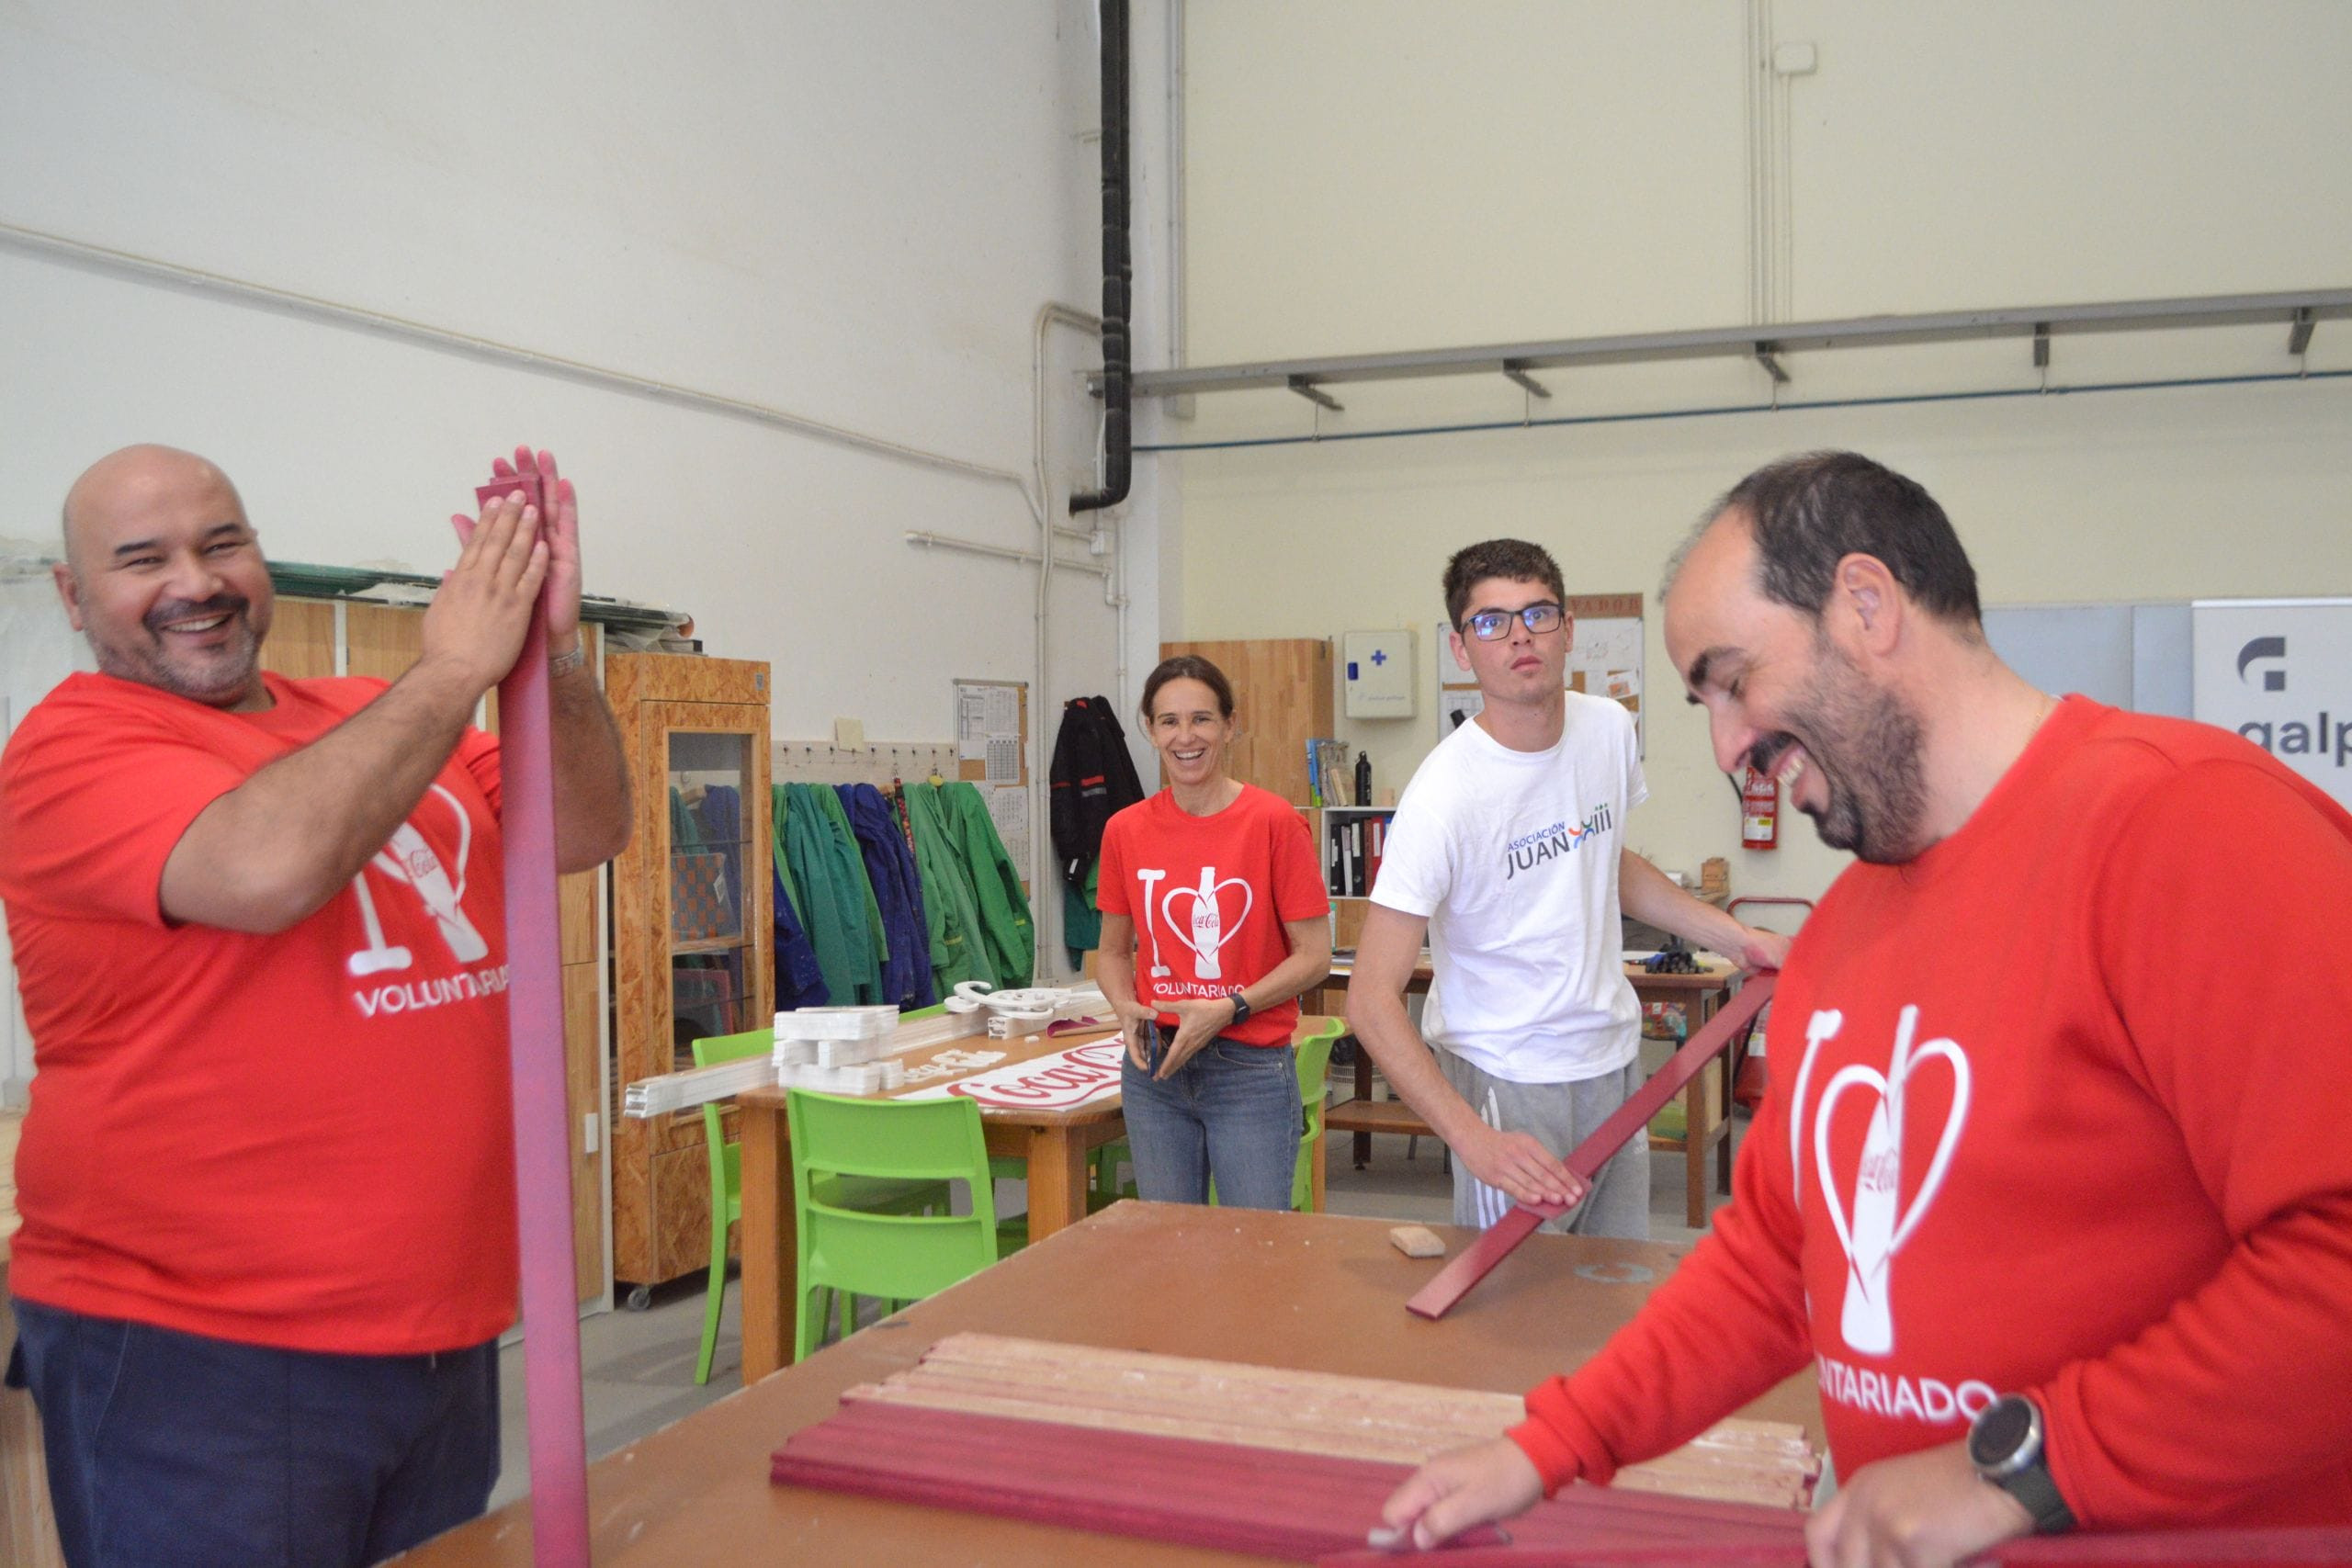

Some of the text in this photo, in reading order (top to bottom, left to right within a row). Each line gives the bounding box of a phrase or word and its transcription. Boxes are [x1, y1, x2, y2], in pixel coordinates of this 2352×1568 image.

[1507, 821, 1566, 852] ASOCIACIÓN
[1507, 831, 1570, 880] JUAN
[354, 964, 510, 1018] VOLUNTARIA
[1817, 1354, 1999, 1423] NTARIADO
